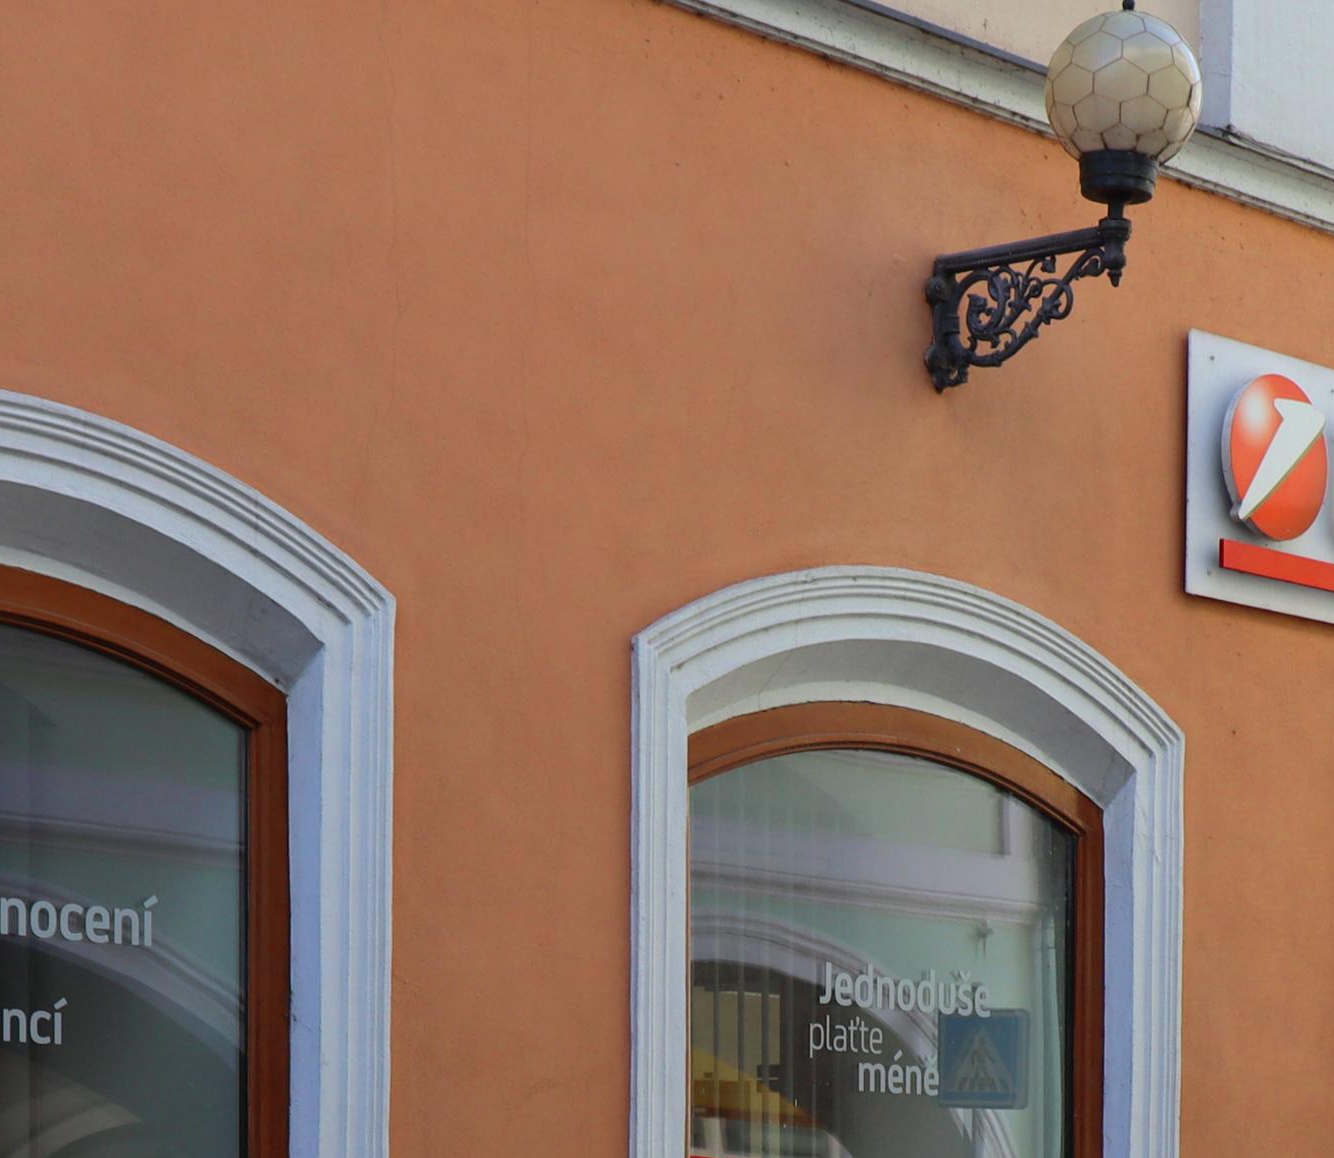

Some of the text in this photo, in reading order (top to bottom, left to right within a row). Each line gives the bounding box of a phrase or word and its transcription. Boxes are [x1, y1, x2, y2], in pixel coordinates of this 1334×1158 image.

[819, 961, 992, 1018] Jednoduše
[809, 1015, 883, 1059] plaťte
[858, 1049, 940, 1097] méně
